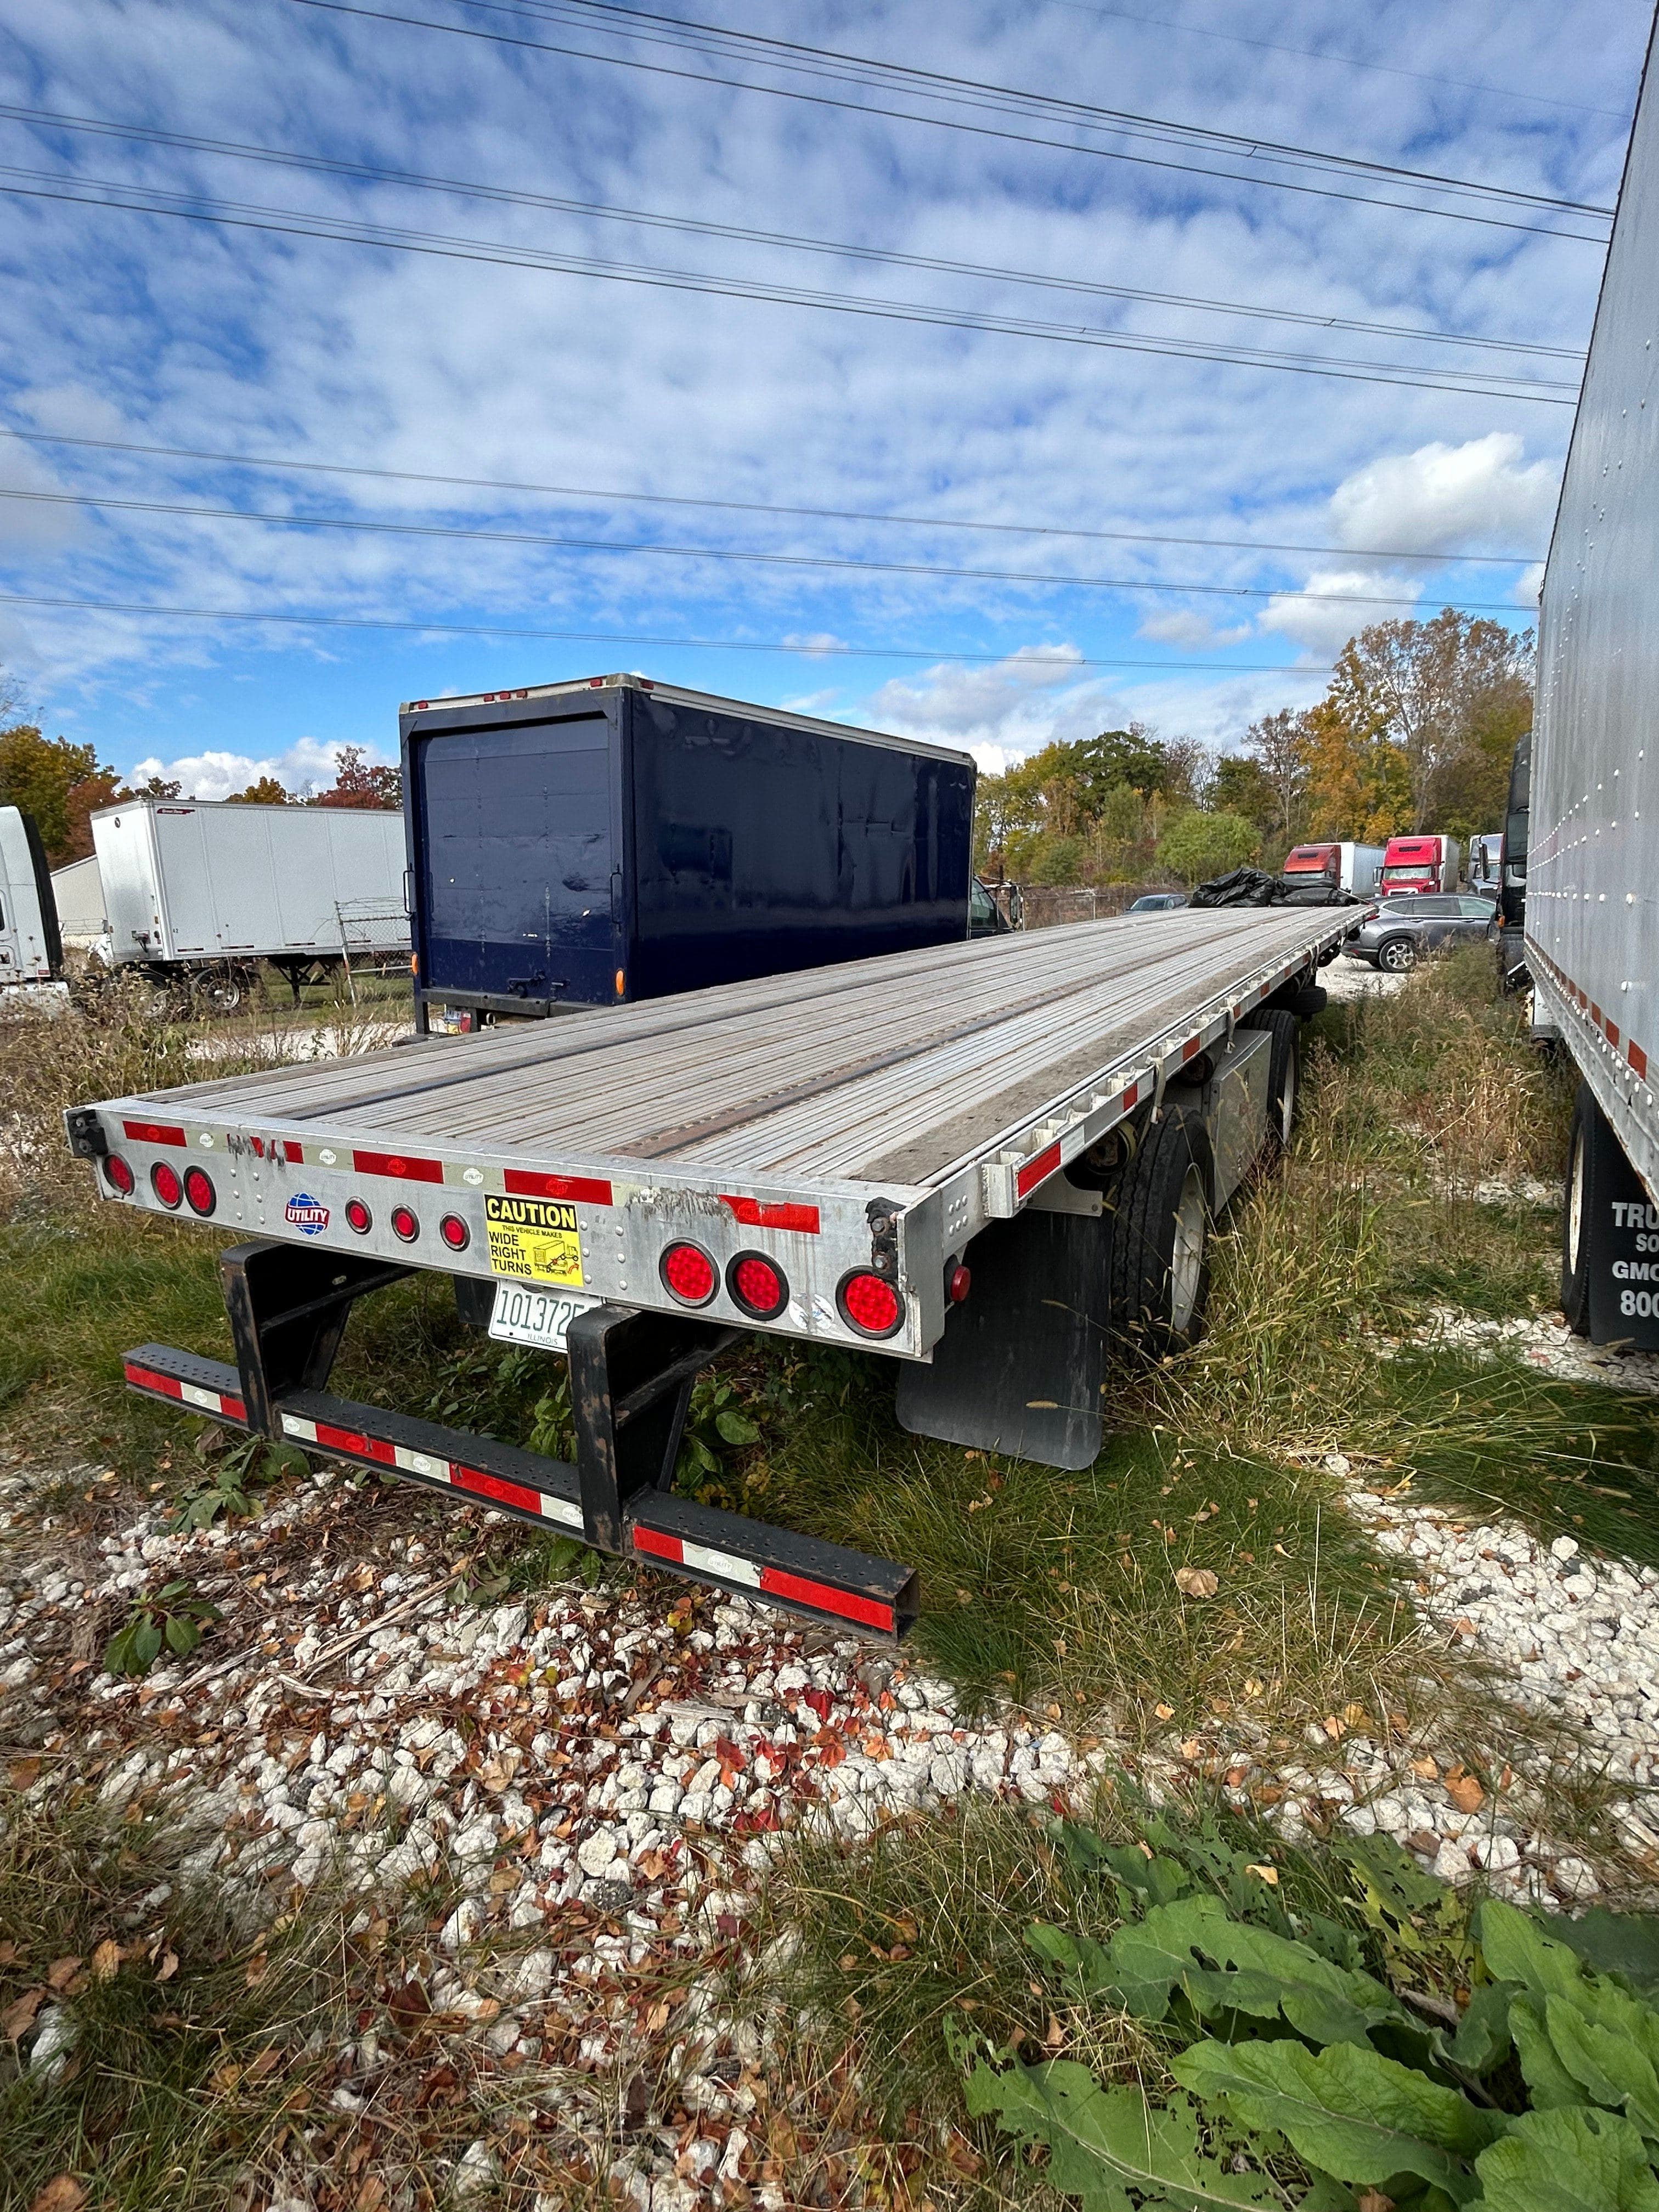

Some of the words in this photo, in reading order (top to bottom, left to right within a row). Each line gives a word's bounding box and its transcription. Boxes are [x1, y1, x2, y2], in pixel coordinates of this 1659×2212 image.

[287, 1209, 328, 1222] UTILITY
[487, 1198, 575, 1229] CAUTION
[1611, 1201, 1659, 1229] TRU
[489, 1231, 520, 1246] WIDE
[516, 1227, 540, 1235] VEHICLE
[541, 1230, 562, 1239] MAKES
[490, 1245, 526, 1261] RIGHT
[492, 1258, 532, 1276] TURNS
[527, 1333, 558, 1346] ILLINOIS
